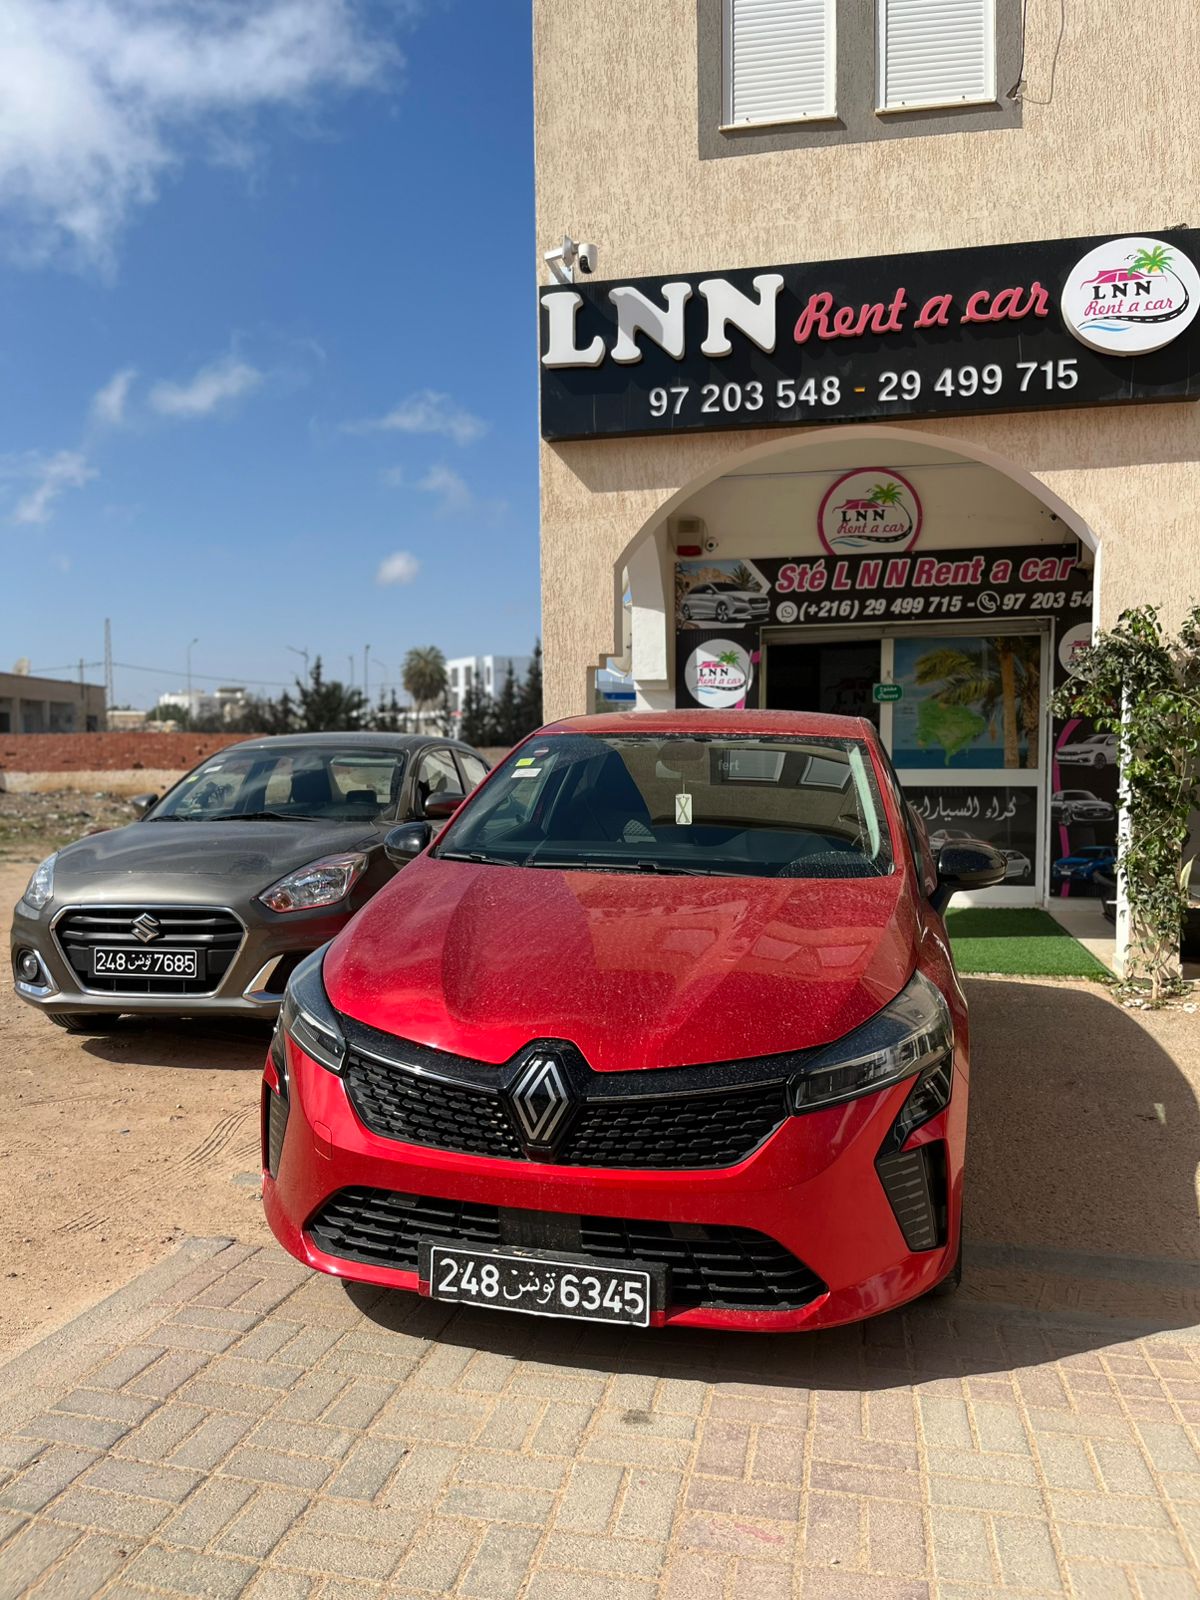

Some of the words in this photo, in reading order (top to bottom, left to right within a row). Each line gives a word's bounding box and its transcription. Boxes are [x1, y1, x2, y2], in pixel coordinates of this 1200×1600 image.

[541, 274, 784, 369] LNN
[793, 287, 908, 344] Rent
[914, 293, 953, 329] a
[960, 281, 1049, 325] car
[1083, 299, 1125, 317] Rent
[1127, 301, 1140, 313] a
[1143, 297, 1173, 312] car
[649, 386, 690, 417] 97
[700, 381, 764, 413] 203
[776, 375, 842, 409] 548
[878, 369, 922, 402] 29
[934, 363, 1003, 398] 499
[1016, 358, 1079, 392] 715
[837, 522, 868, 535] Rent
[870, 523, 879, 533] a
[882, 522, 905, 533] car
[775, 558, 828, 593] Sté
[912, 555, 985, 587] Rent
[990, 559, 1013, 584] a
[1019, 557, 1078, 583] car
[800, 600, 860, 622] (+216)
[863, 598, 887, 616] 29
[890, 597, 925, 615] 499
[928, 595, 963, 613] 715
[1002, 593, 1026, 610] 97
[1030, 591, 1066, 609] 203
[1069, 590, 1093, 608] 54
[696, 676, 717, 685] Rent
[727, 677, 742, 685] car
[985, 795, 1017, 821] كراء
[96, 952, 126, 970] 248
[127, 954, 152, 971] تونس
[154, 954, 195, 973] 7685
[438, 1257, 500, 1299] 248
[503, 1268, 556, 1304] تونس
[560, 1273, 644, 1315] 6345
